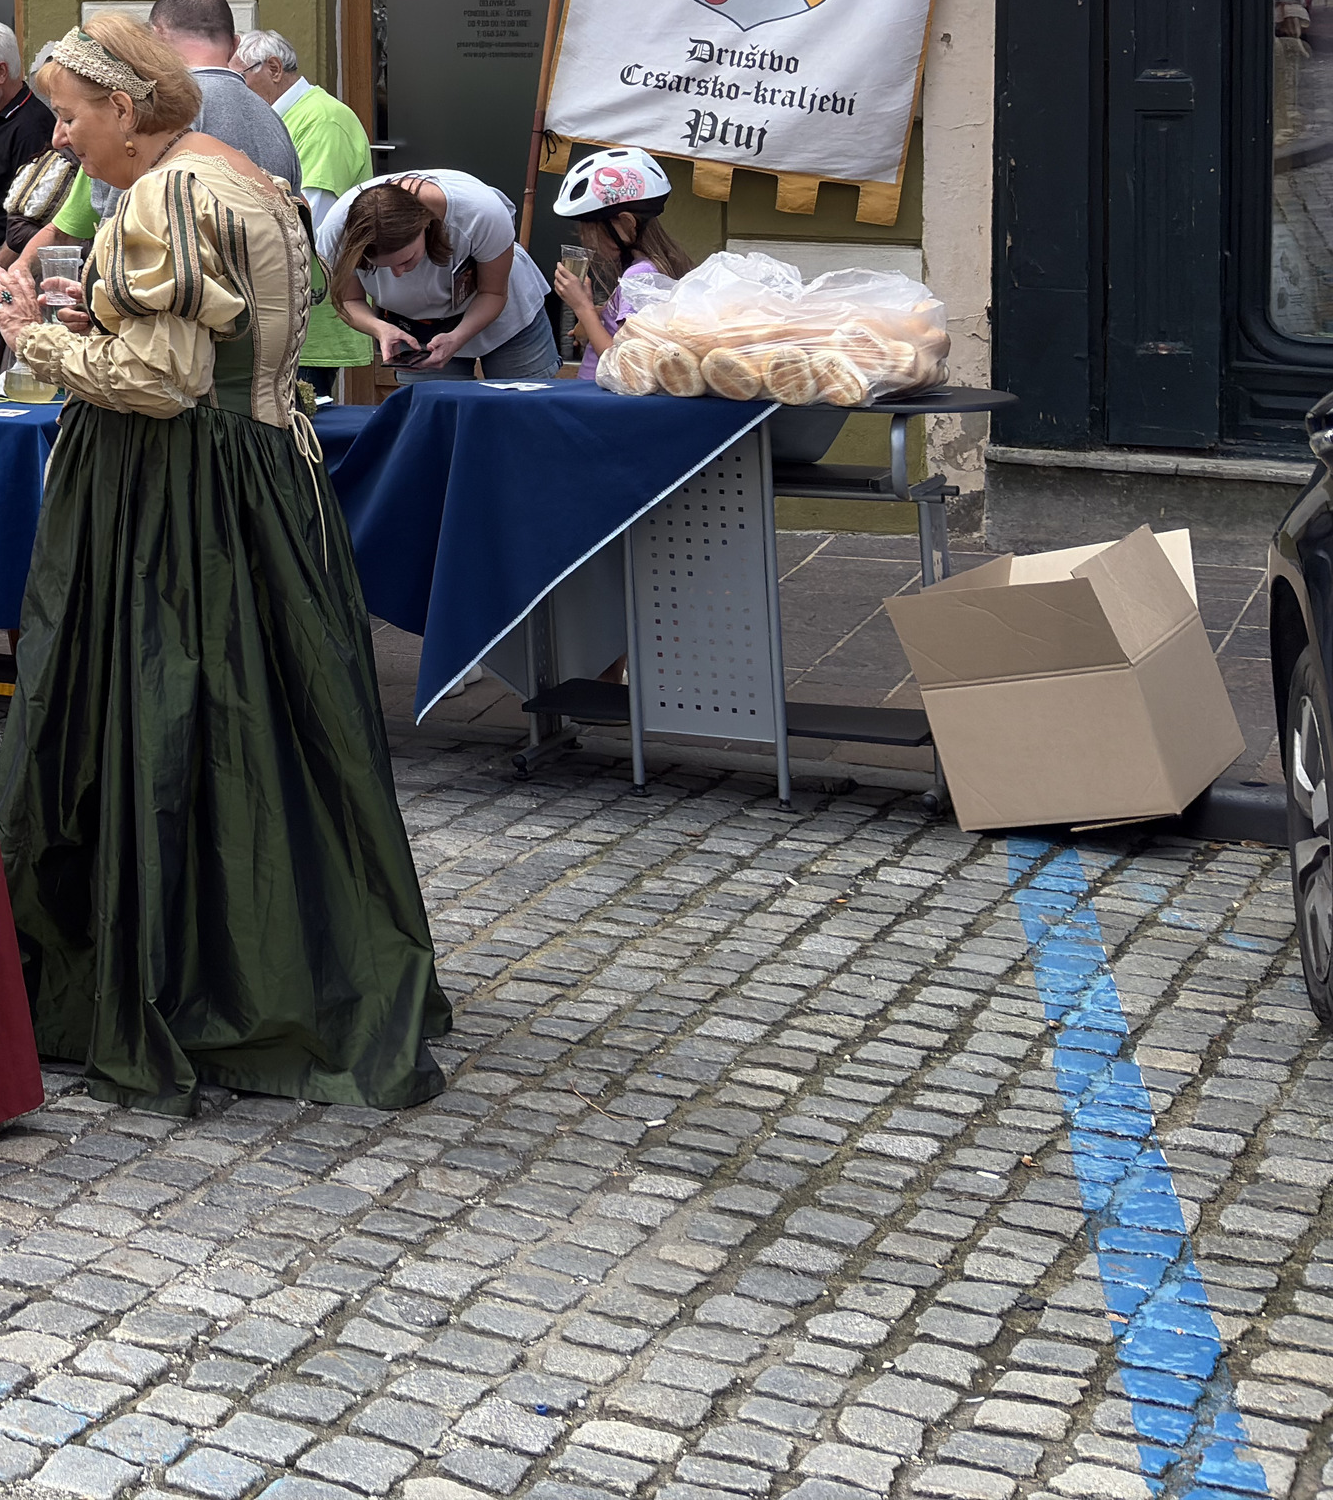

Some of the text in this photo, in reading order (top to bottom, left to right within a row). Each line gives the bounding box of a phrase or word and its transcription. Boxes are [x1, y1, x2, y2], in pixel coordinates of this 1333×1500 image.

[686, 37, 800, 74] Društvo
[620, 63, 858, 116] Cesarsko-kraljevi
[680, 108, 770, 157] Ptuj
